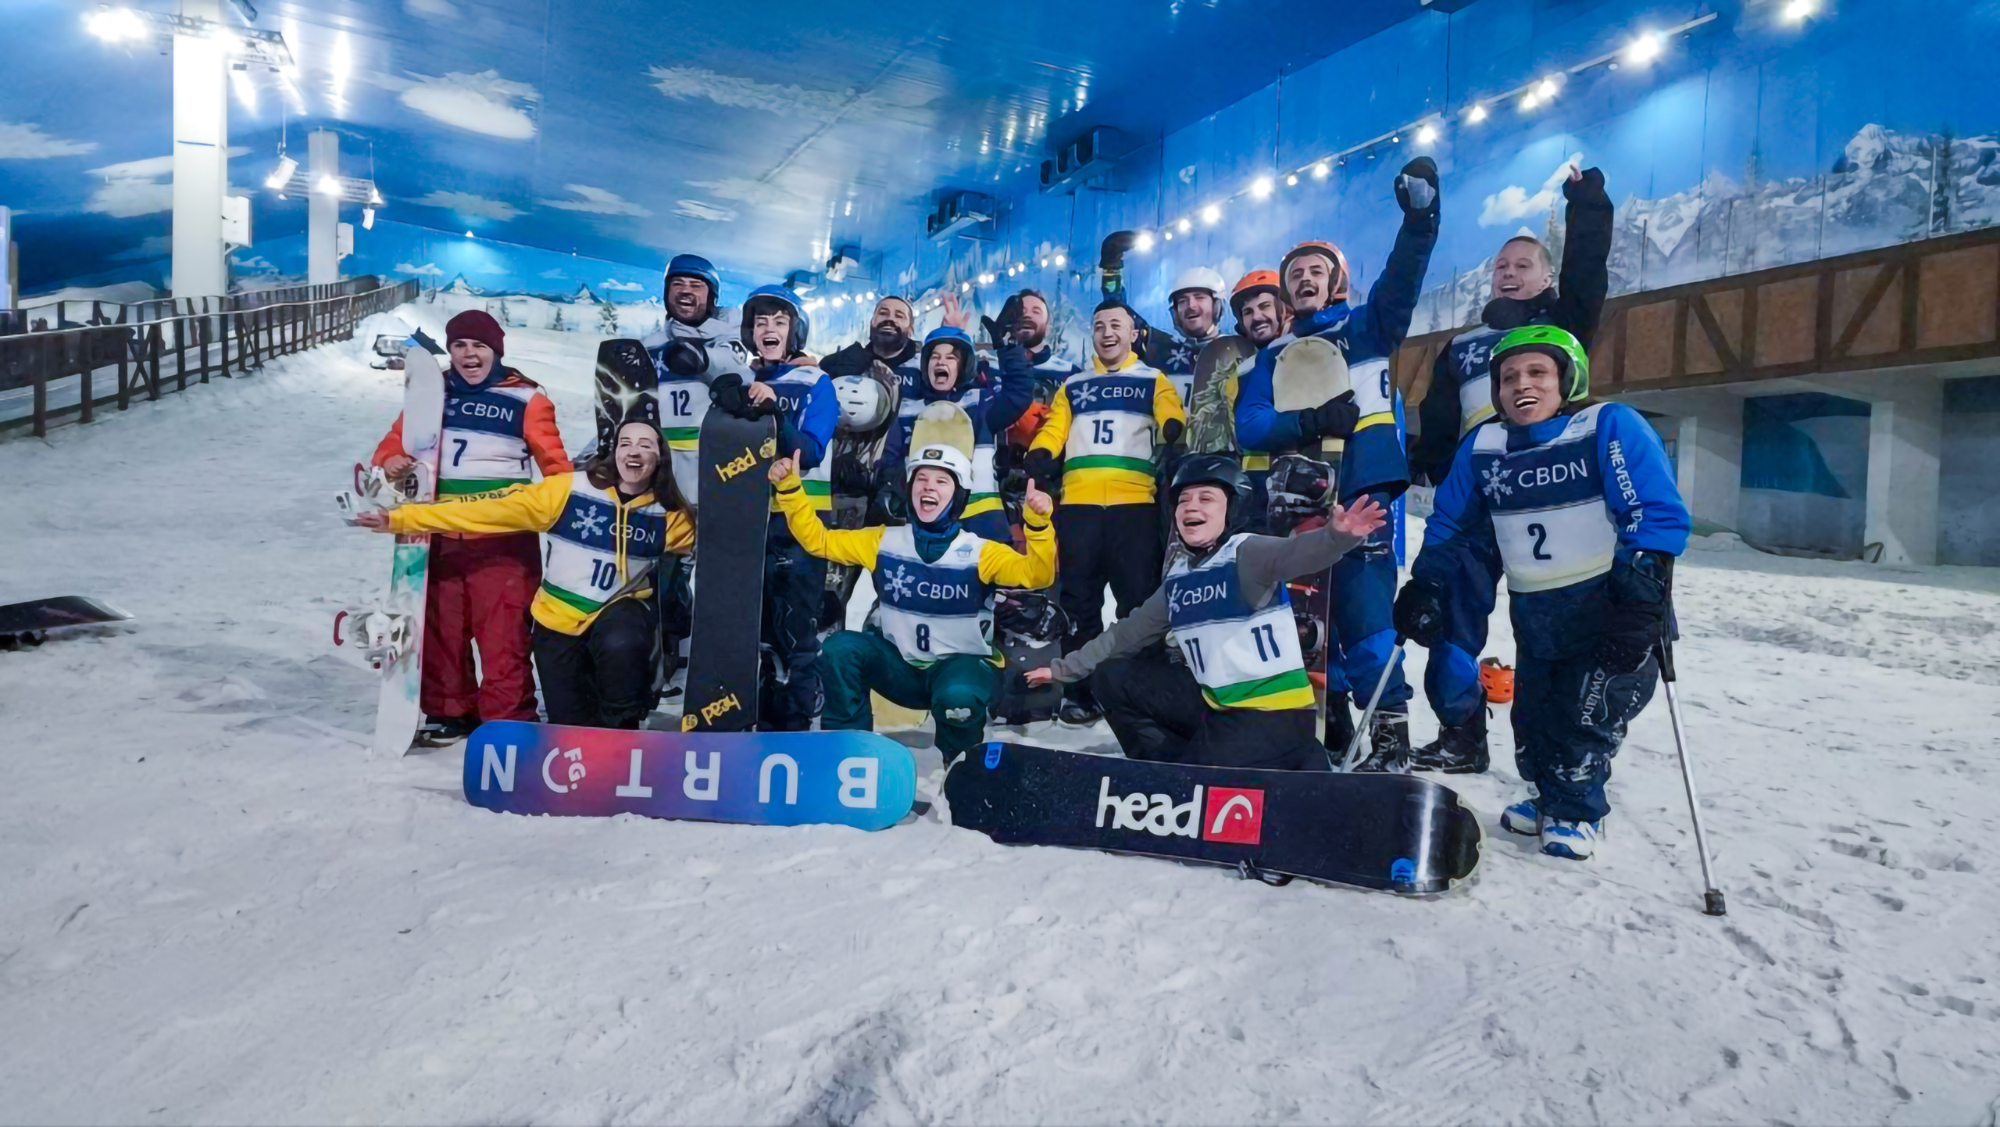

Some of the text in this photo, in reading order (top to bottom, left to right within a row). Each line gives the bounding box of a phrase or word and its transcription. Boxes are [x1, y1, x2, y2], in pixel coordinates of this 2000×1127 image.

[670, 389, 692, 417] 12
[1101, 386, 1146, 399] CBDN
[461, 402, 514, 423] CBDN
[1091, 419, 1115, 445] 15
[452, 438, 468, 467] 7
[715, 447, 757, 482] head
[1518, 458, 1588, 488] CBDN
[608, 522, 656, 544] CBDN
[1527, 522, 1552, 561] 2
[590, 558, 617, 591] 10
[917, 581, 969, 600] CBDN
[1182, 581, 1227, 606] CBDN
[916, 623, 930, 653] 8
[1250, 623, 1281, 662] 11
[1581, 667, 1606, 726] owland
[1095, 776, 1204, 839] head
